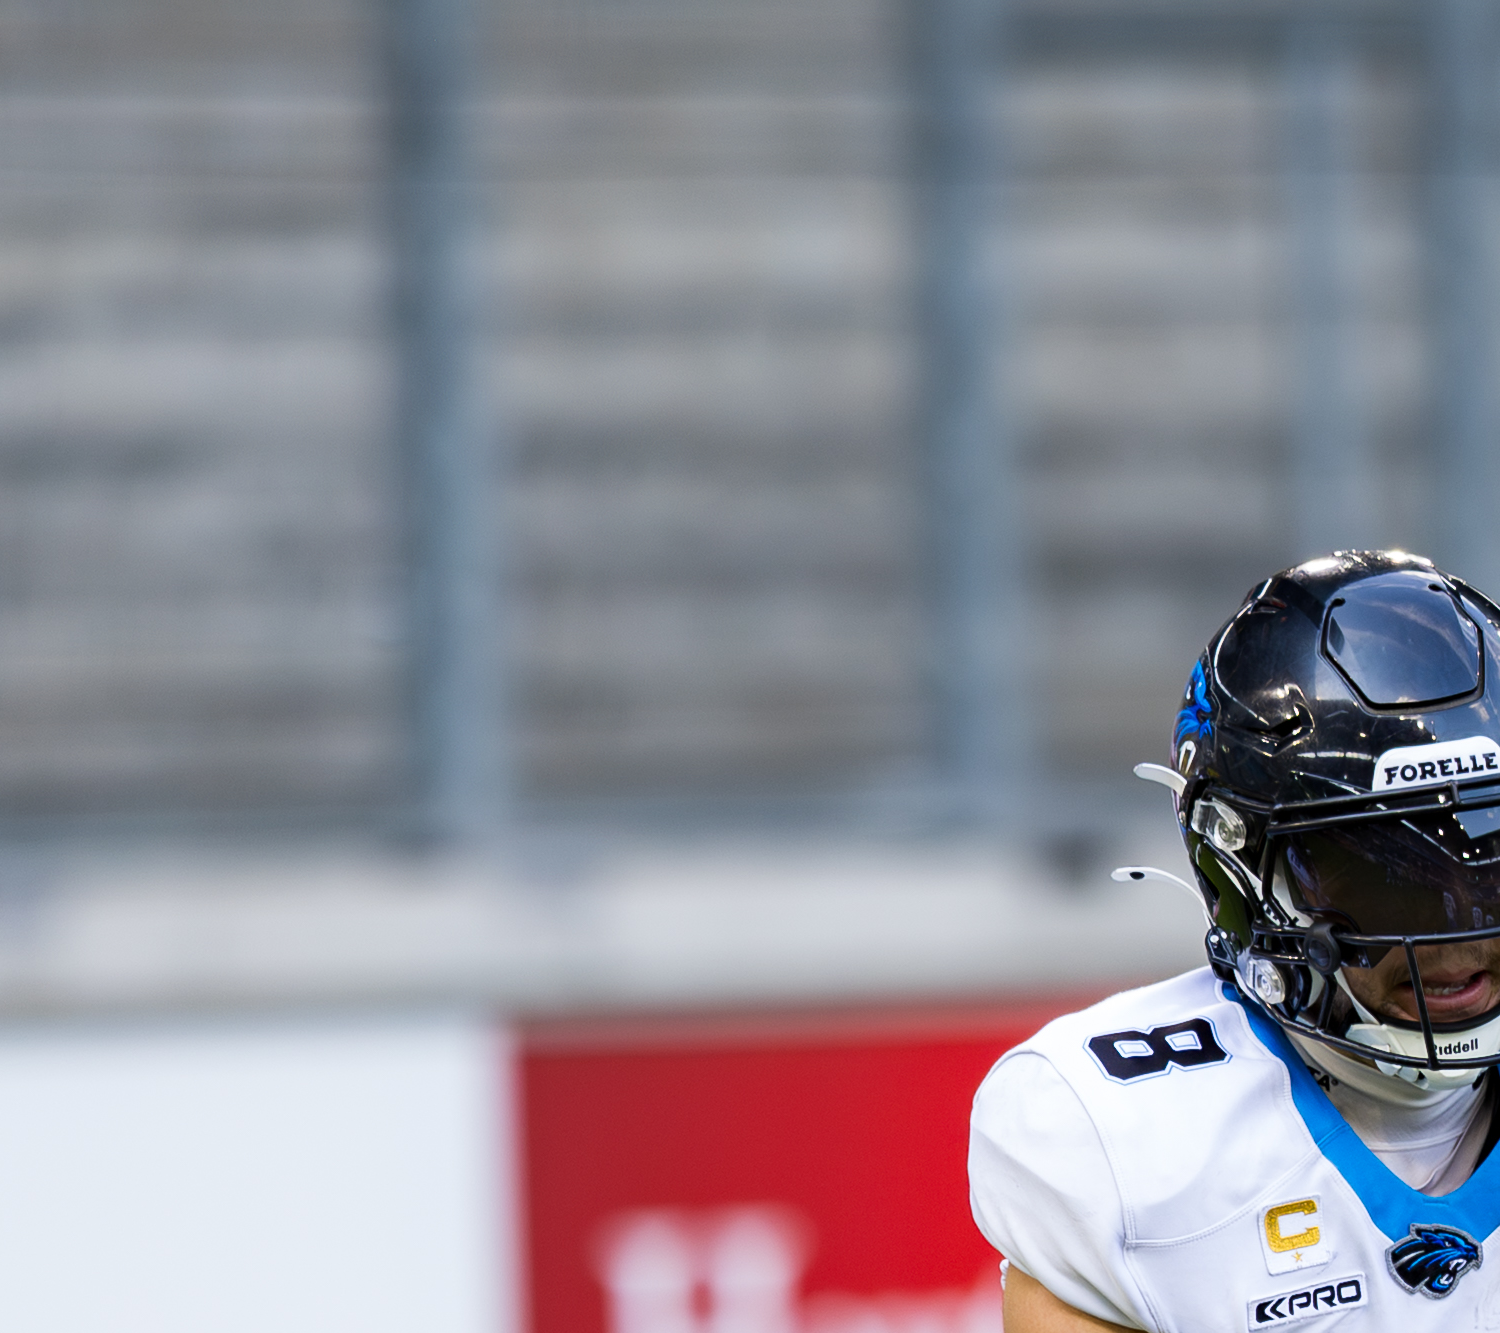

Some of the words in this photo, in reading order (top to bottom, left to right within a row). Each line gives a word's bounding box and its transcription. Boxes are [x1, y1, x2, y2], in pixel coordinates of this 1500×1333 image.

[1384, 751, 1499, 785] FORELLE
[1084, 1015, 1234, 1086] 8
[1263, 1198, 1321, 1254] C
